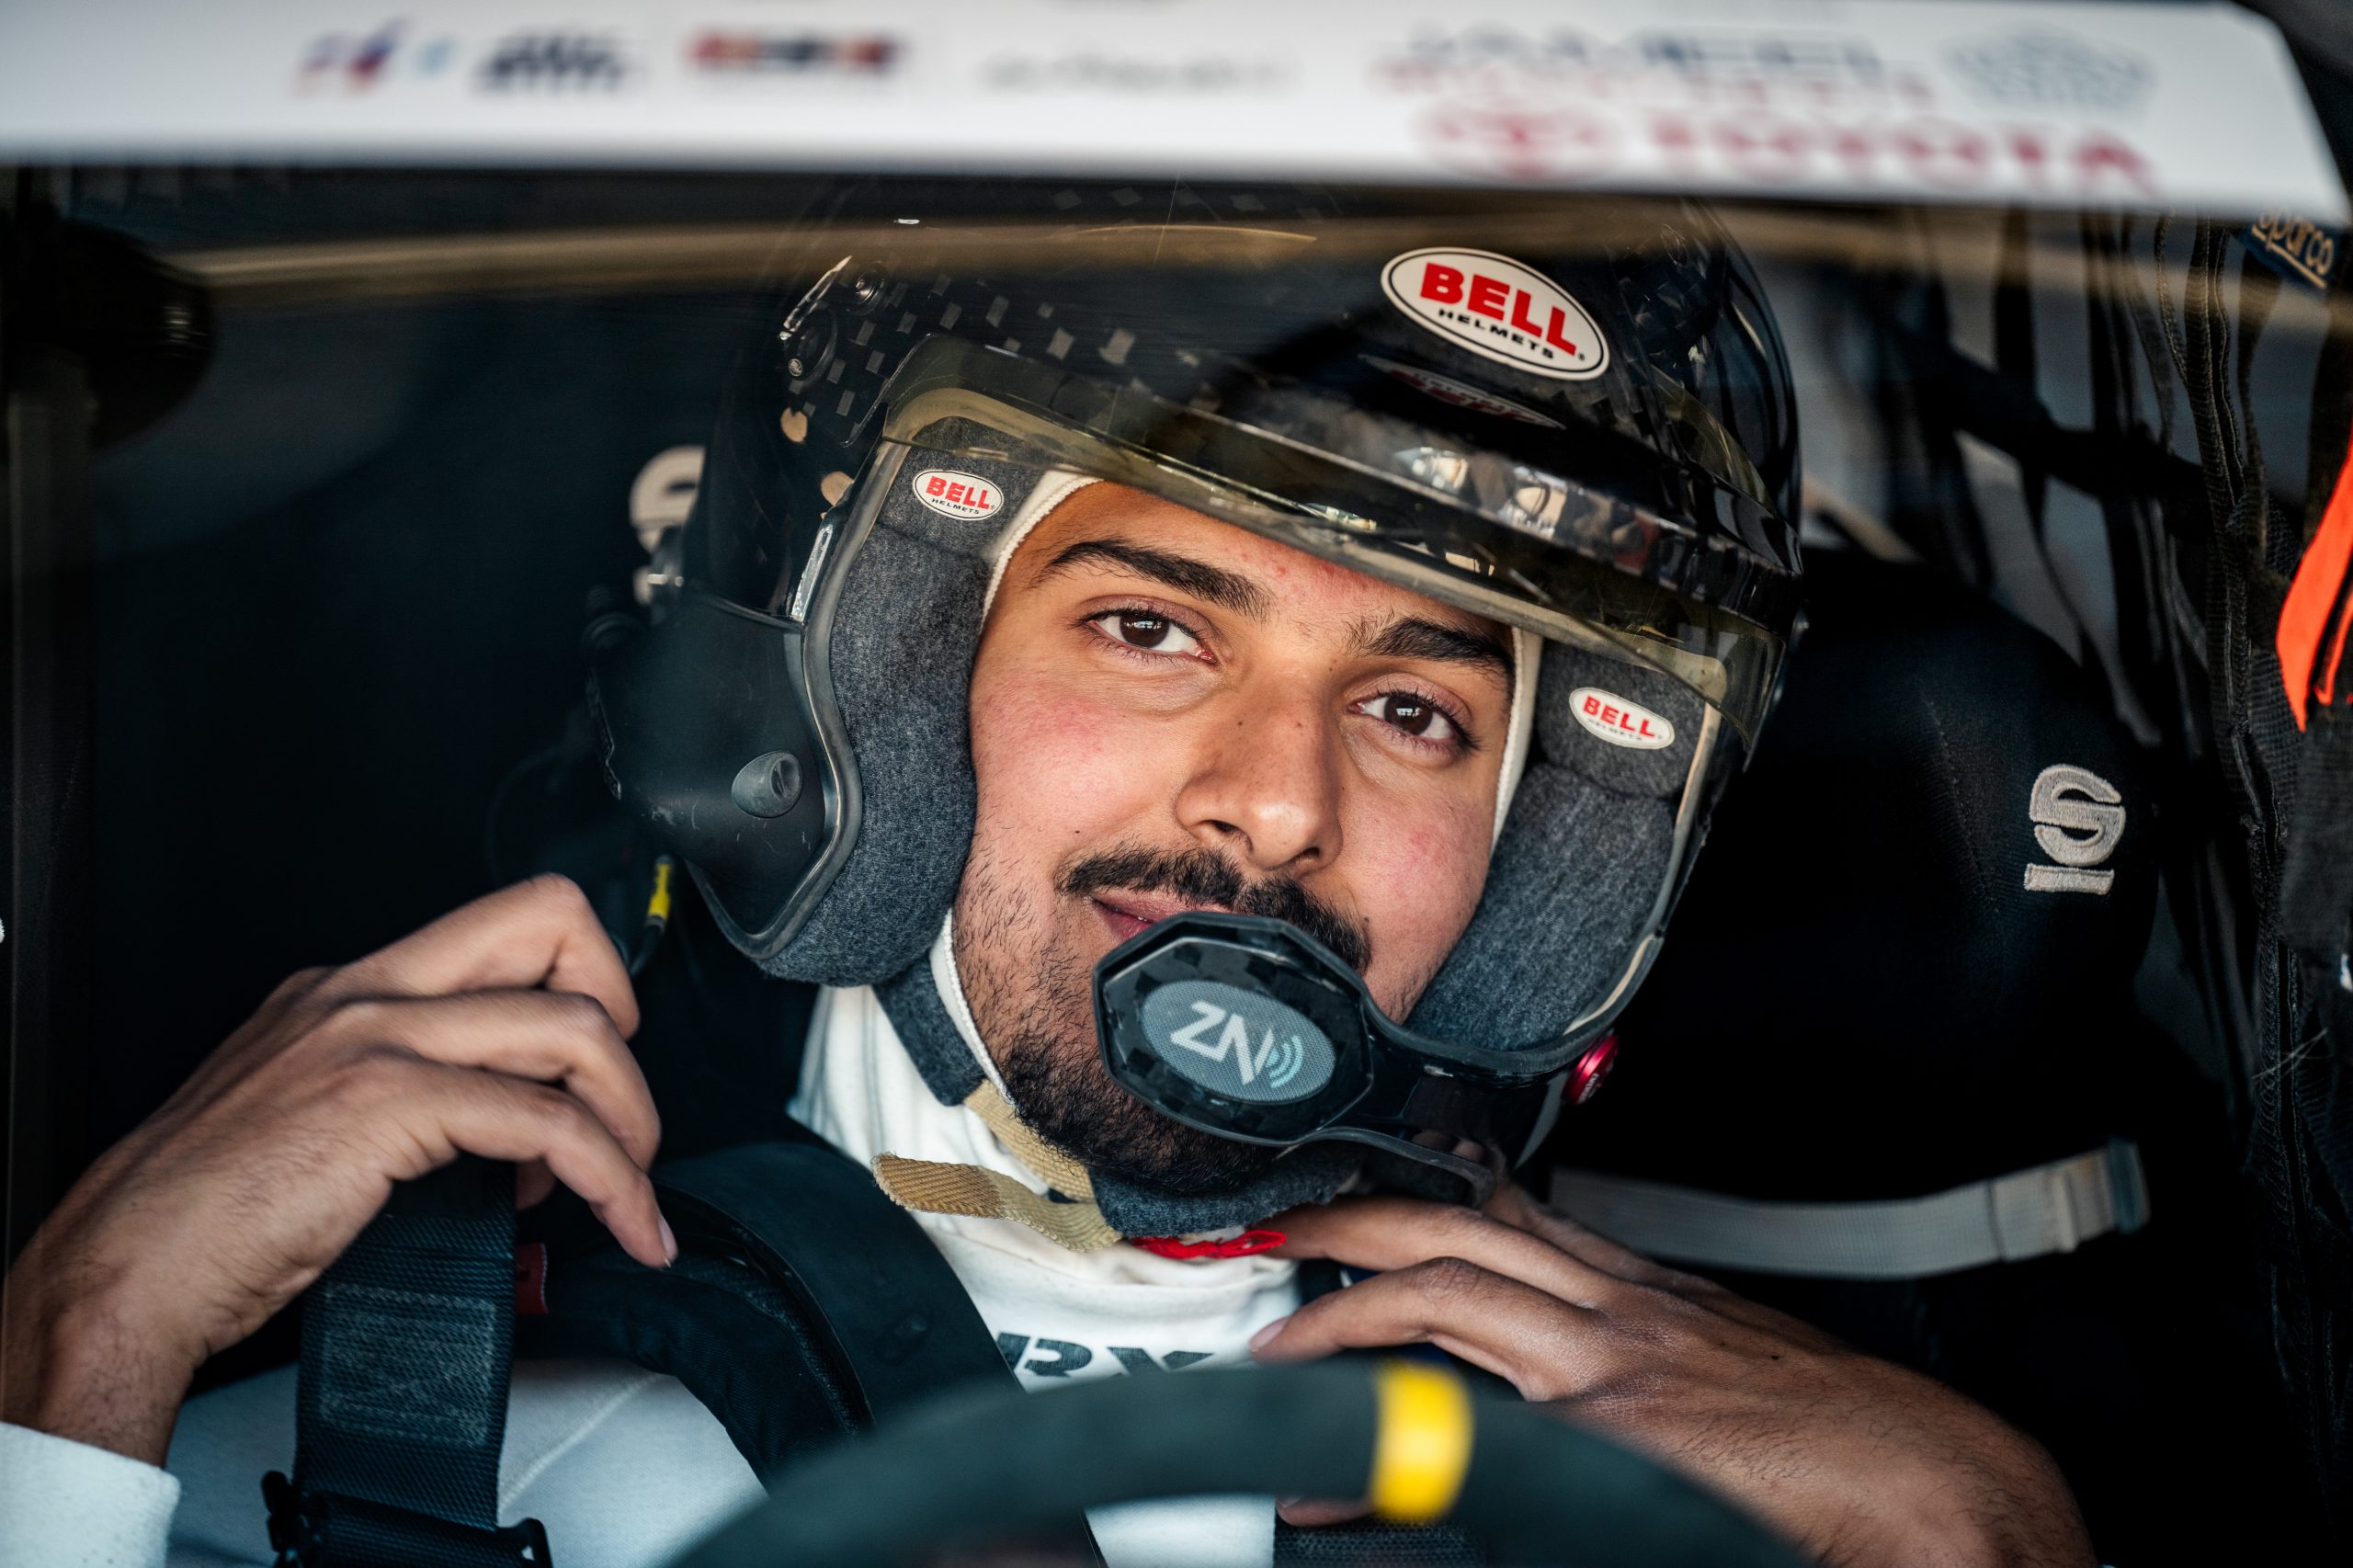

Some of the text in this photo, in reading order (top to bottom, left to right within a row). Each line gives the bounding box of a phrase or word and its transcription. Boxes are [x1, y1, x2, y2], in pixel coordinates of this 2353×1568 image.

[1420, 263, 1576, 357] BELL
[1438, 308, 1554, 360] HELMETS
[926, 475, 991, 510] BELL
[931, 498, 980, 515] HELMETS
[1583, 695, 1655, 739] BELL
